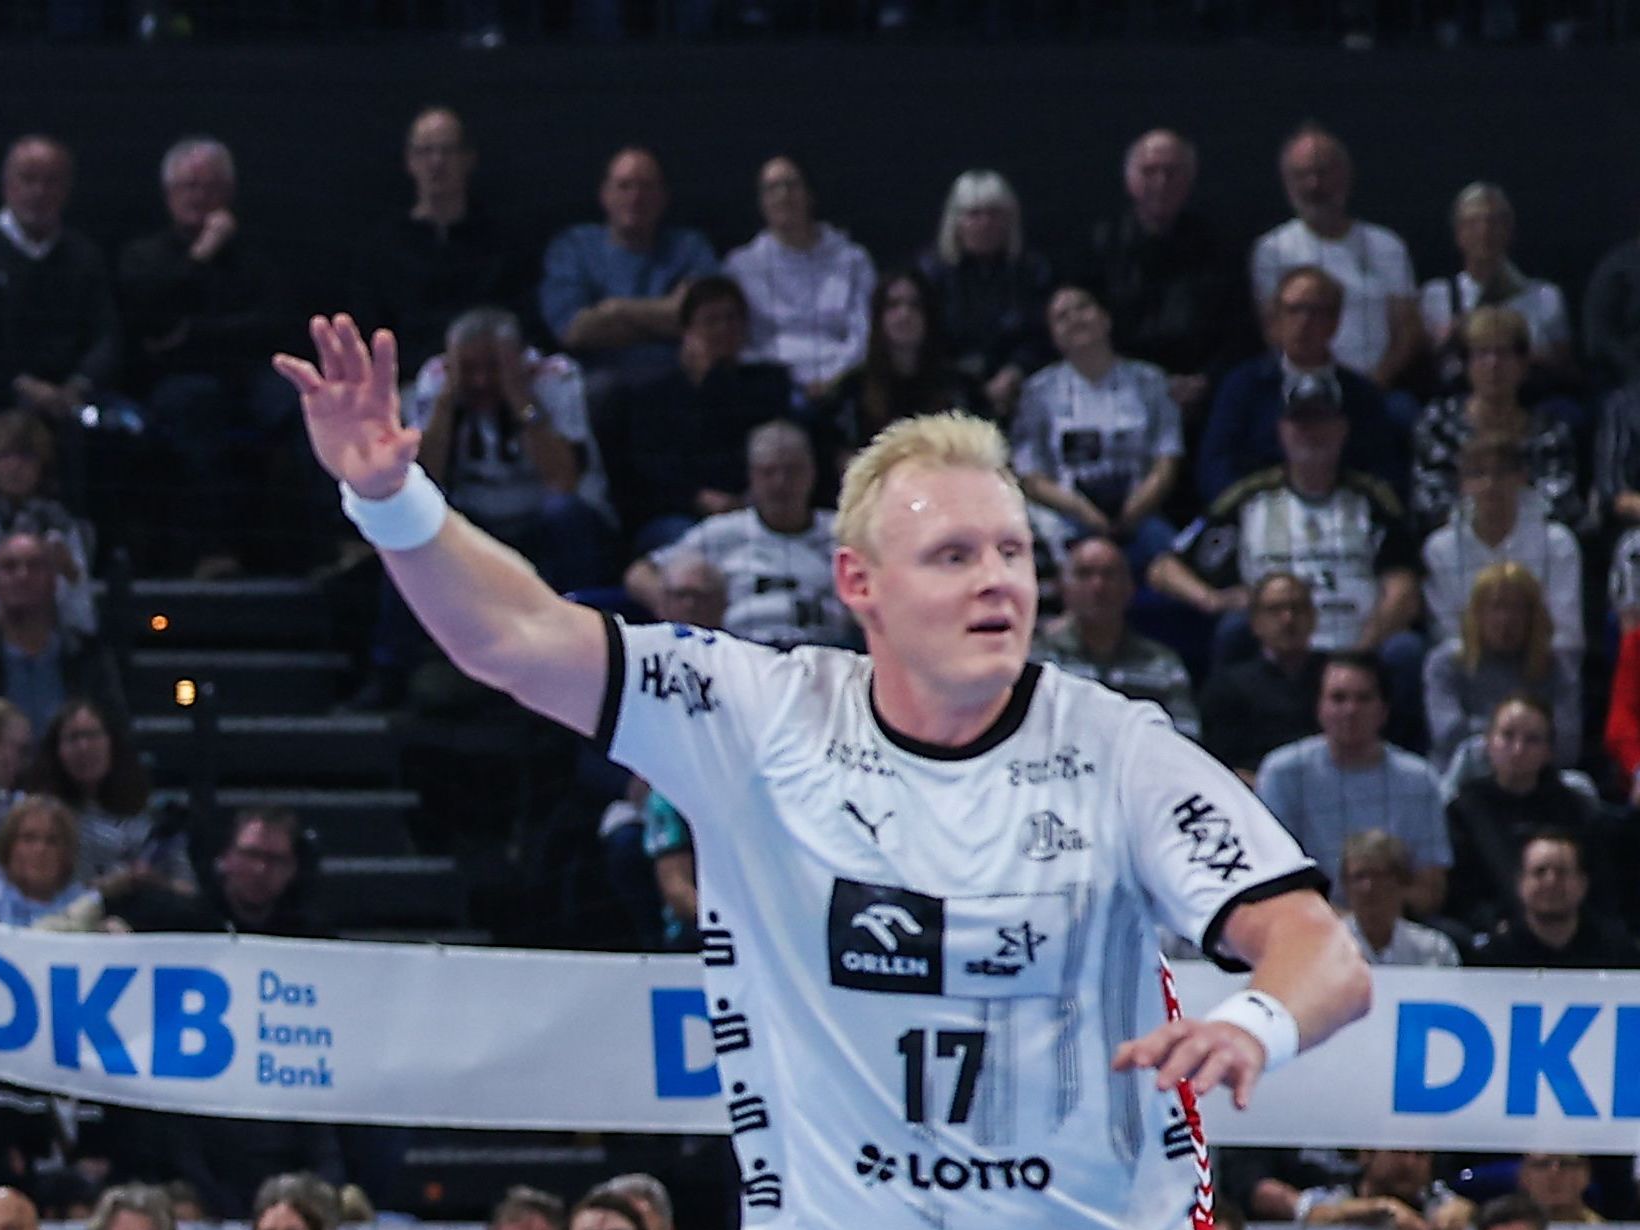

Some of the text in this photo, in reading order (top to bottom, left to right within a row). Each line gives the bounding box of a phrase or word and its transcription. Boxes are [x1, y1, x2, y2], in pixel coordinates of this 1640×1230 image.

[259, 969, 317, 1007] Das
[258, 1011, 333, 1049] kann
[258, 1052, 334, 1088] Bank
[897, 1028, 986, 1124] 17
[907, 1152, 1052, 1191] LOTTO
